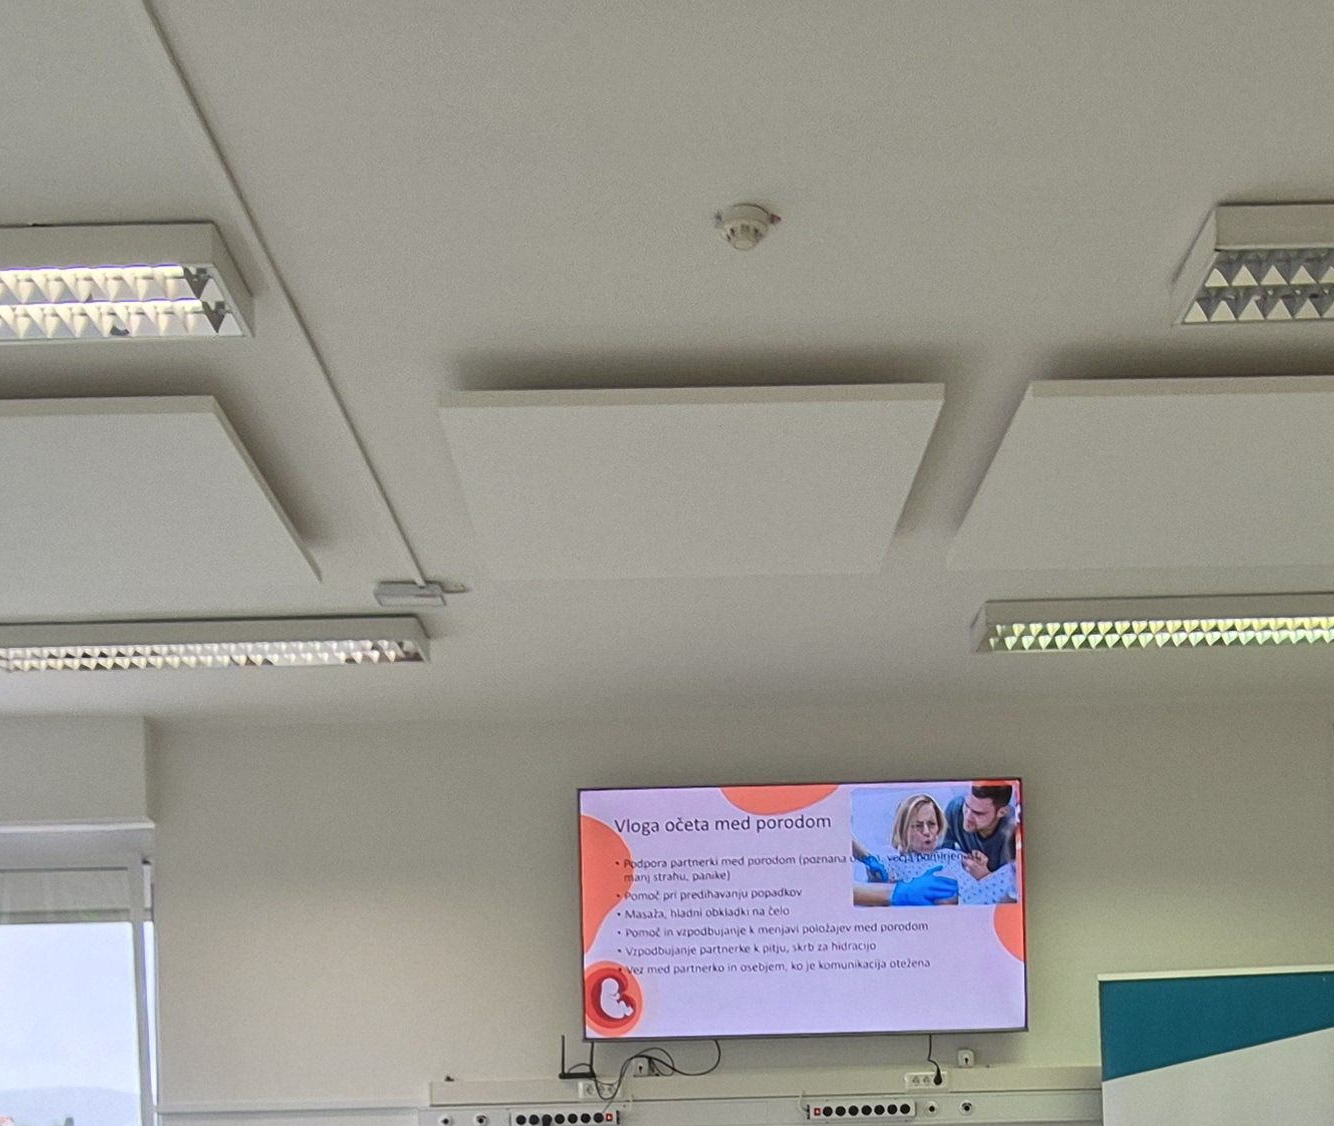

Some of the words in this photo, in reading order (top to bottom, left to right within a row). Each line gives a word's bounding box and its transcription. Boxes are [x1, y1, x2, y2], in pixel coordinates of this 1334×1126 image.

[614, 818, 659, 836] Vloga
[665, 817, 709, 833] očeta
[715, 815, 751, 831] med
[756, 814, 832, 833] porodom
[624, 858, 668, 869] Podpora
[671, 857, 718, 868] partnerki
[721, 856, 745, 866] med
[748, 855, 796, 867] porodom
[798, 854, 847, 866] (poznana
[624, 872, 650, 884] manj
[653, 870, 689, 882] strahu,
[692, 870, 731, 882] panike)
[624, 890, 660, 901] Pomoč
[663, 890, 677, 901] pri
[680, 888, 749, 901] predihavanju
[751, 887, 802, 899] popadkov
[625, 907, 667, 920] Masaža,
[670, 906, 703, 918] hladni
[705, 905, 750, 917] obkladki
[752, 907, 765, 916] na
[768, 905, 790, 916] čelo
[625, 927, 661, 938] Pomoč
[664, 927, 674, 936] in
[676, 925, 746, 938] vzpodbujanje
[749, 924, 755, 934] k
[757, 923, 799, 936] menjavi
[802, 922, 851, 935] položajev
[854, 922, 877, 933] med
[880, 921, 929, 933] porodom
[625, 944, 697, 957] Vzpodbujanje
[700, 943, 751, 955] partnerke
[753, 943, 759, 953] k
[762, 942, 790, 955] pitju,
[793, 942, 814, 952] skrb
[817, 943, 828, 952] za
[831, 941, 876, 953] hidracijo
[626, 964, 644, 975] Vez
[647, 963, 670, 974] med
[673, 963, 725, 975] partnerko
[727, 962, 738, 972] in
[740, 961, 788, 974] osebjem,
[791, 961, 803, 971] ko
[805, 960, 816, 972] je
[818, 958, 886, 971] komunikacija
[889, 957, 931, 969] otežena
